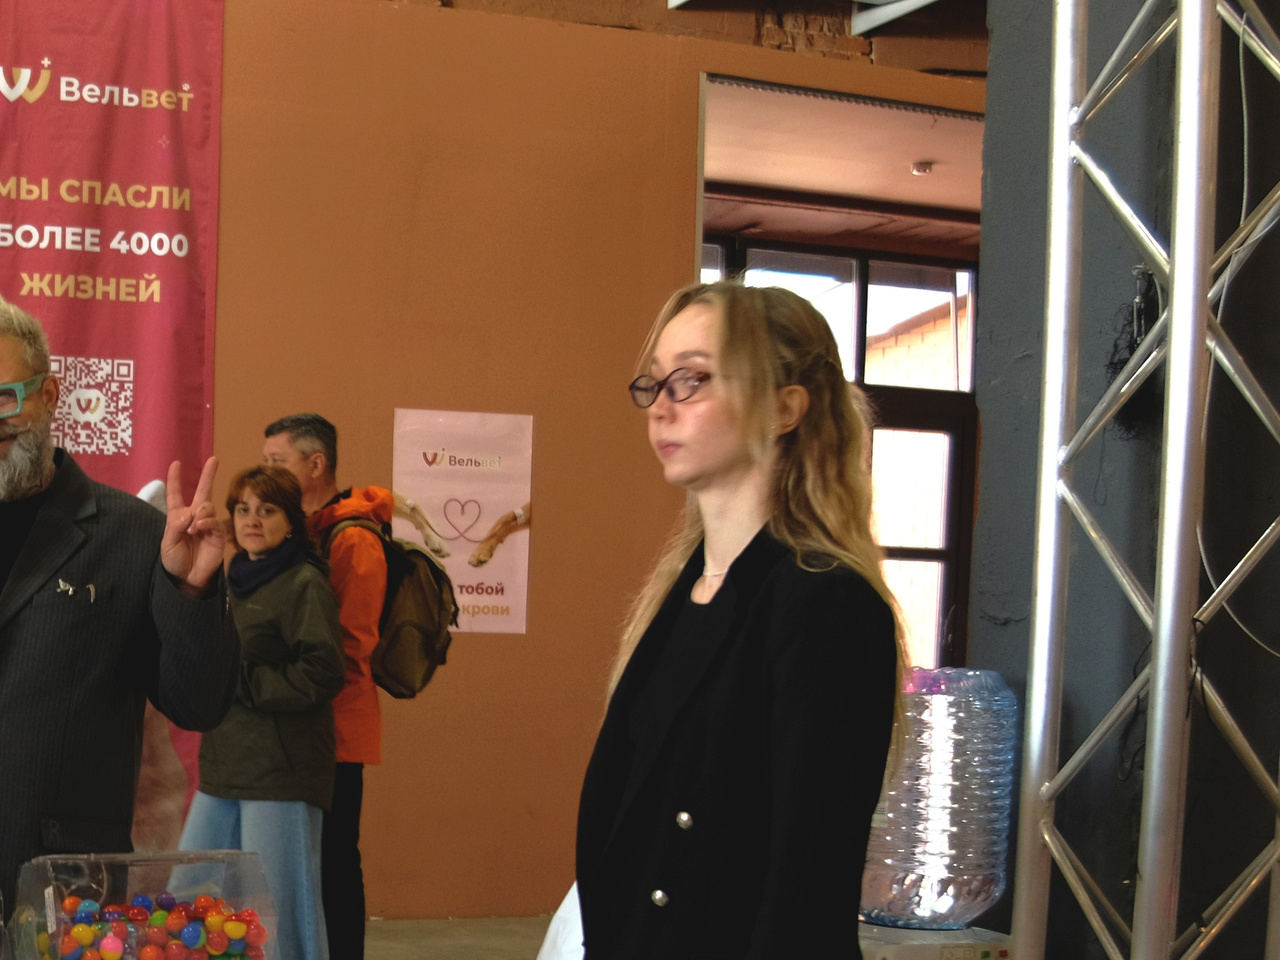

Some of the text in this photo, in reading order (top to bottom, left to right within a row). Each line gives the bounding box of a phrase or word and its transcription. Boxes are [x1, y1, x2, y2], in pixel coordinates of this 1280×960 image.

[60, 76, 194, 112] Вельвет
[59, 179, 191, 212] СПАСЛИ
[109, 230, 189, 258] 4000
[20, 272, 161, 303] ЖИЗНЕЙ
[457, 582, 505, 596] тобой
[461, 604, 510, 618] крови
